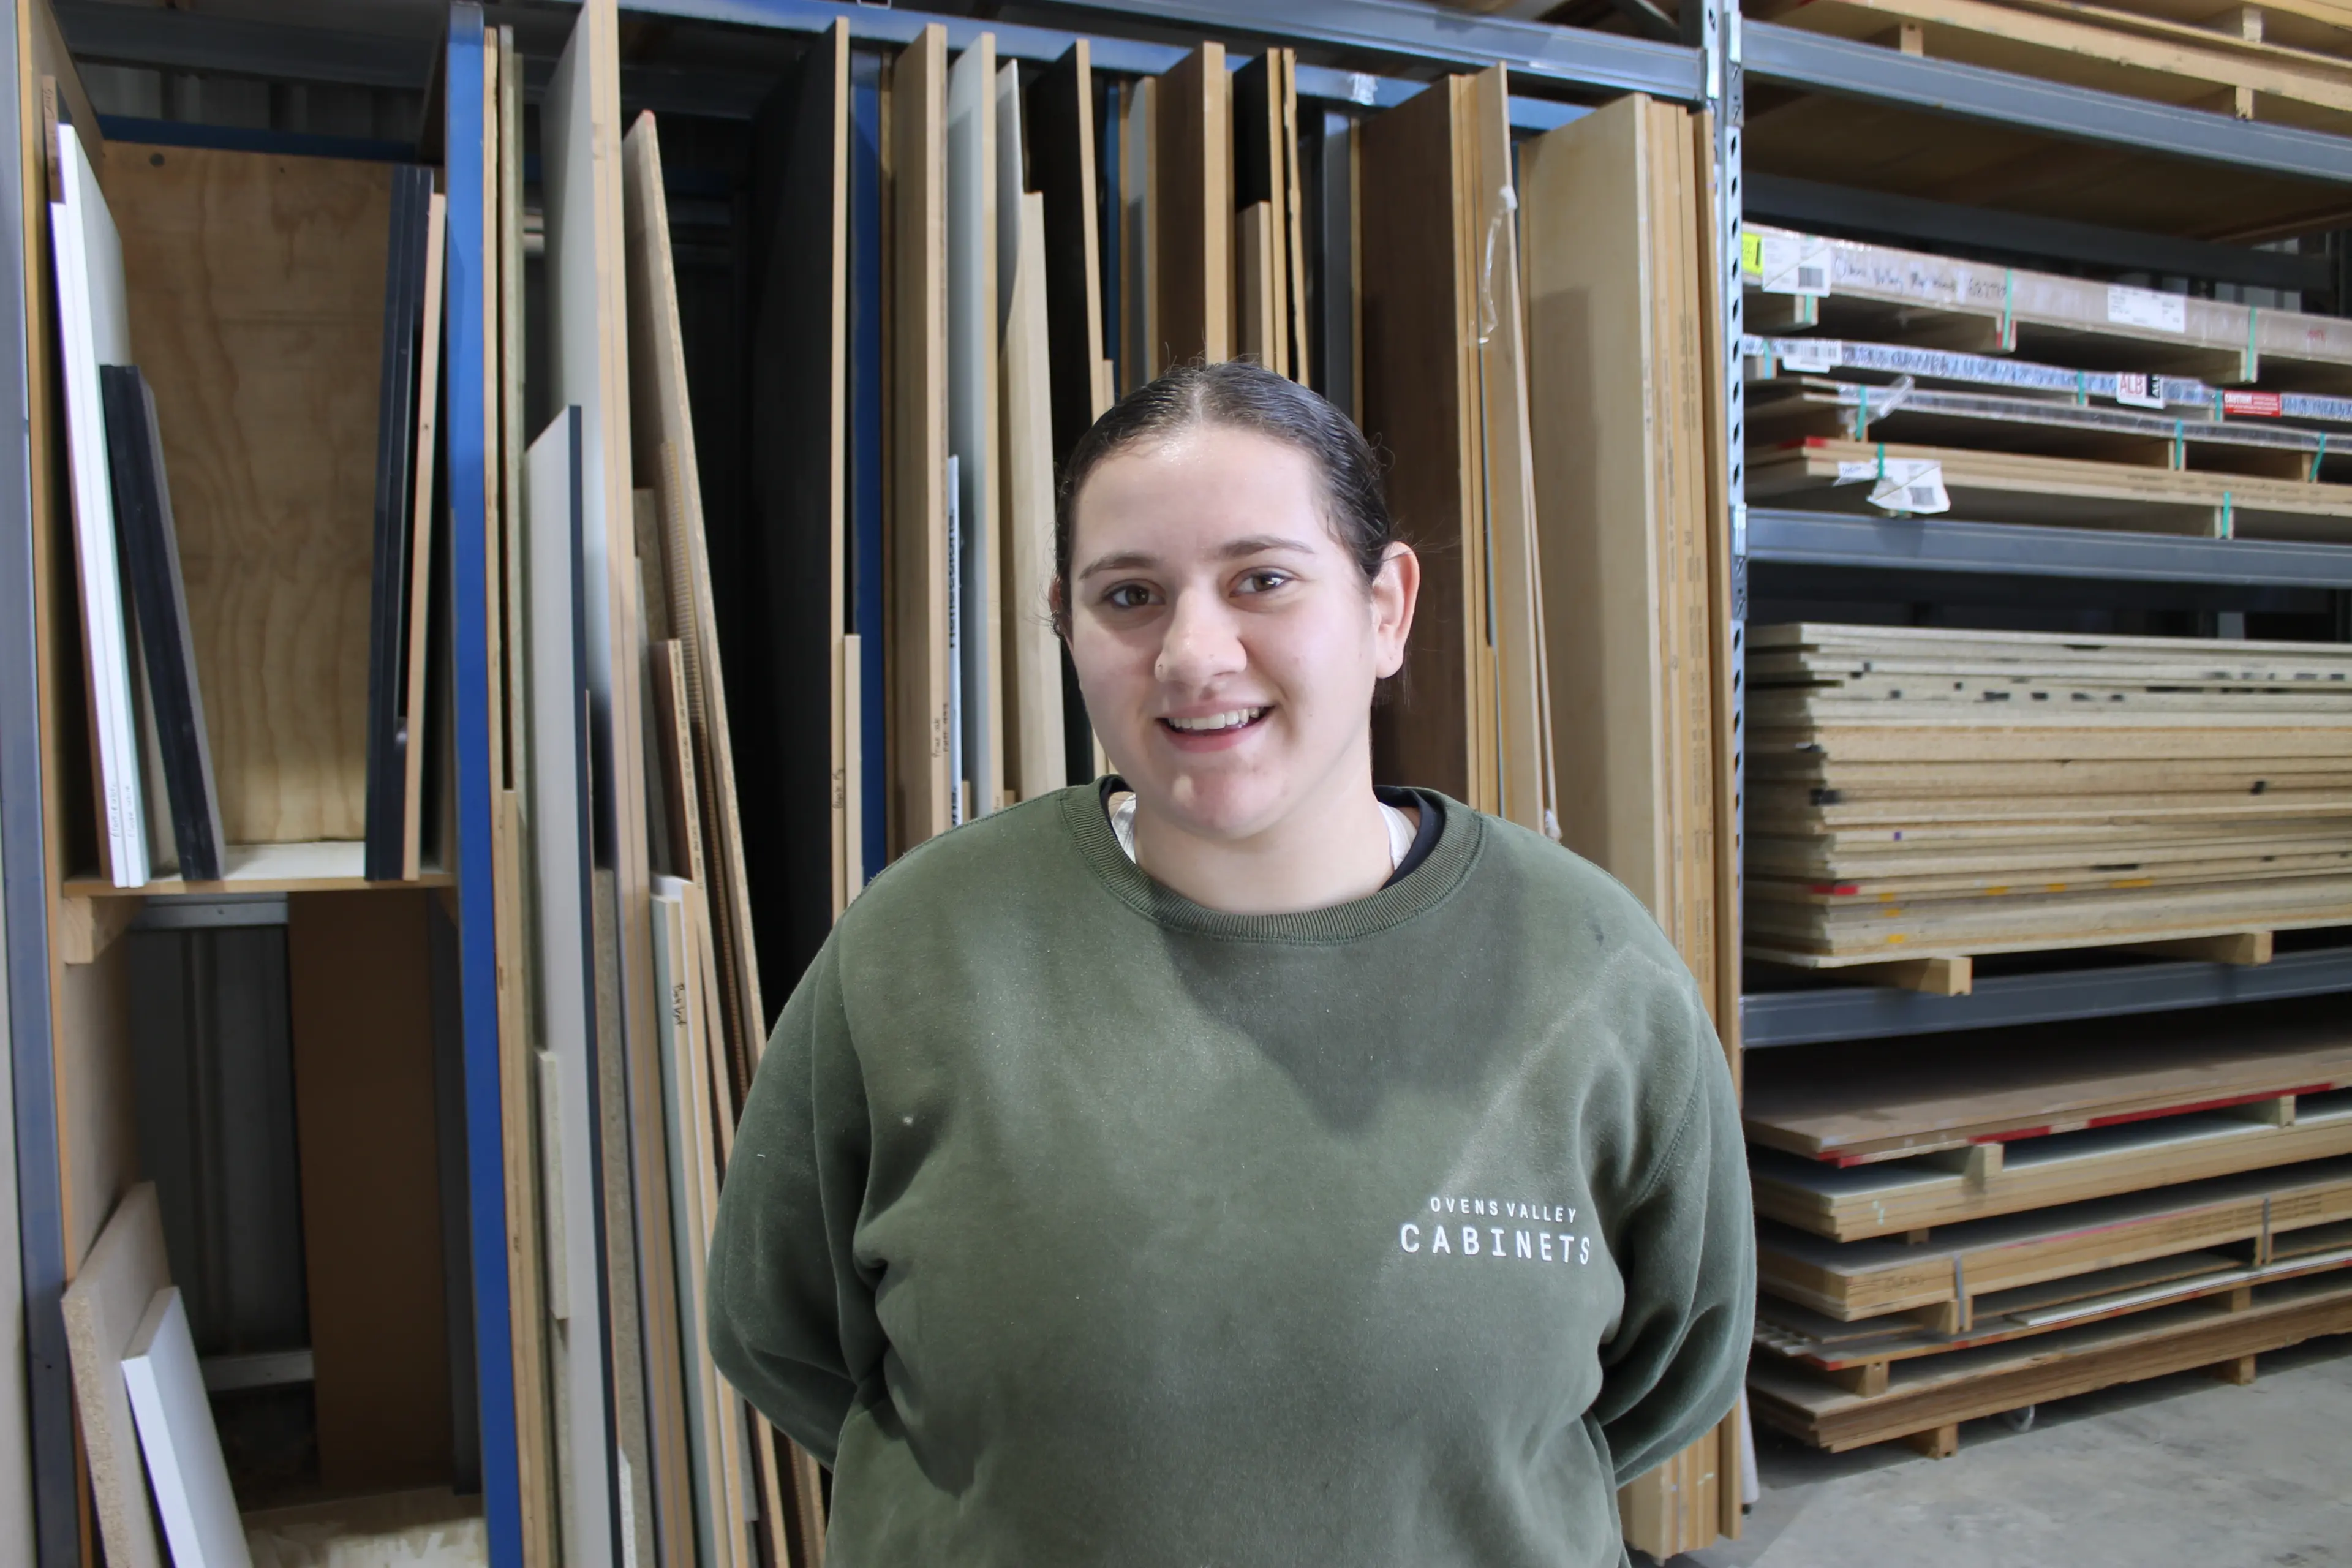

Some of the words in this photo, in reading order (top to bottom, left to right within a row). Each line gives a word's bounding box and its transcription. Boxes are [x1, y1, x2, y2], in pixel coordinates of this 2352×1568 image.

[1430, 1197, 1498, 1216] OVENS
[1506, 1202, 1576, 1223] VALLEY
[1401, 1224, 1590, 1265] CABINETS
